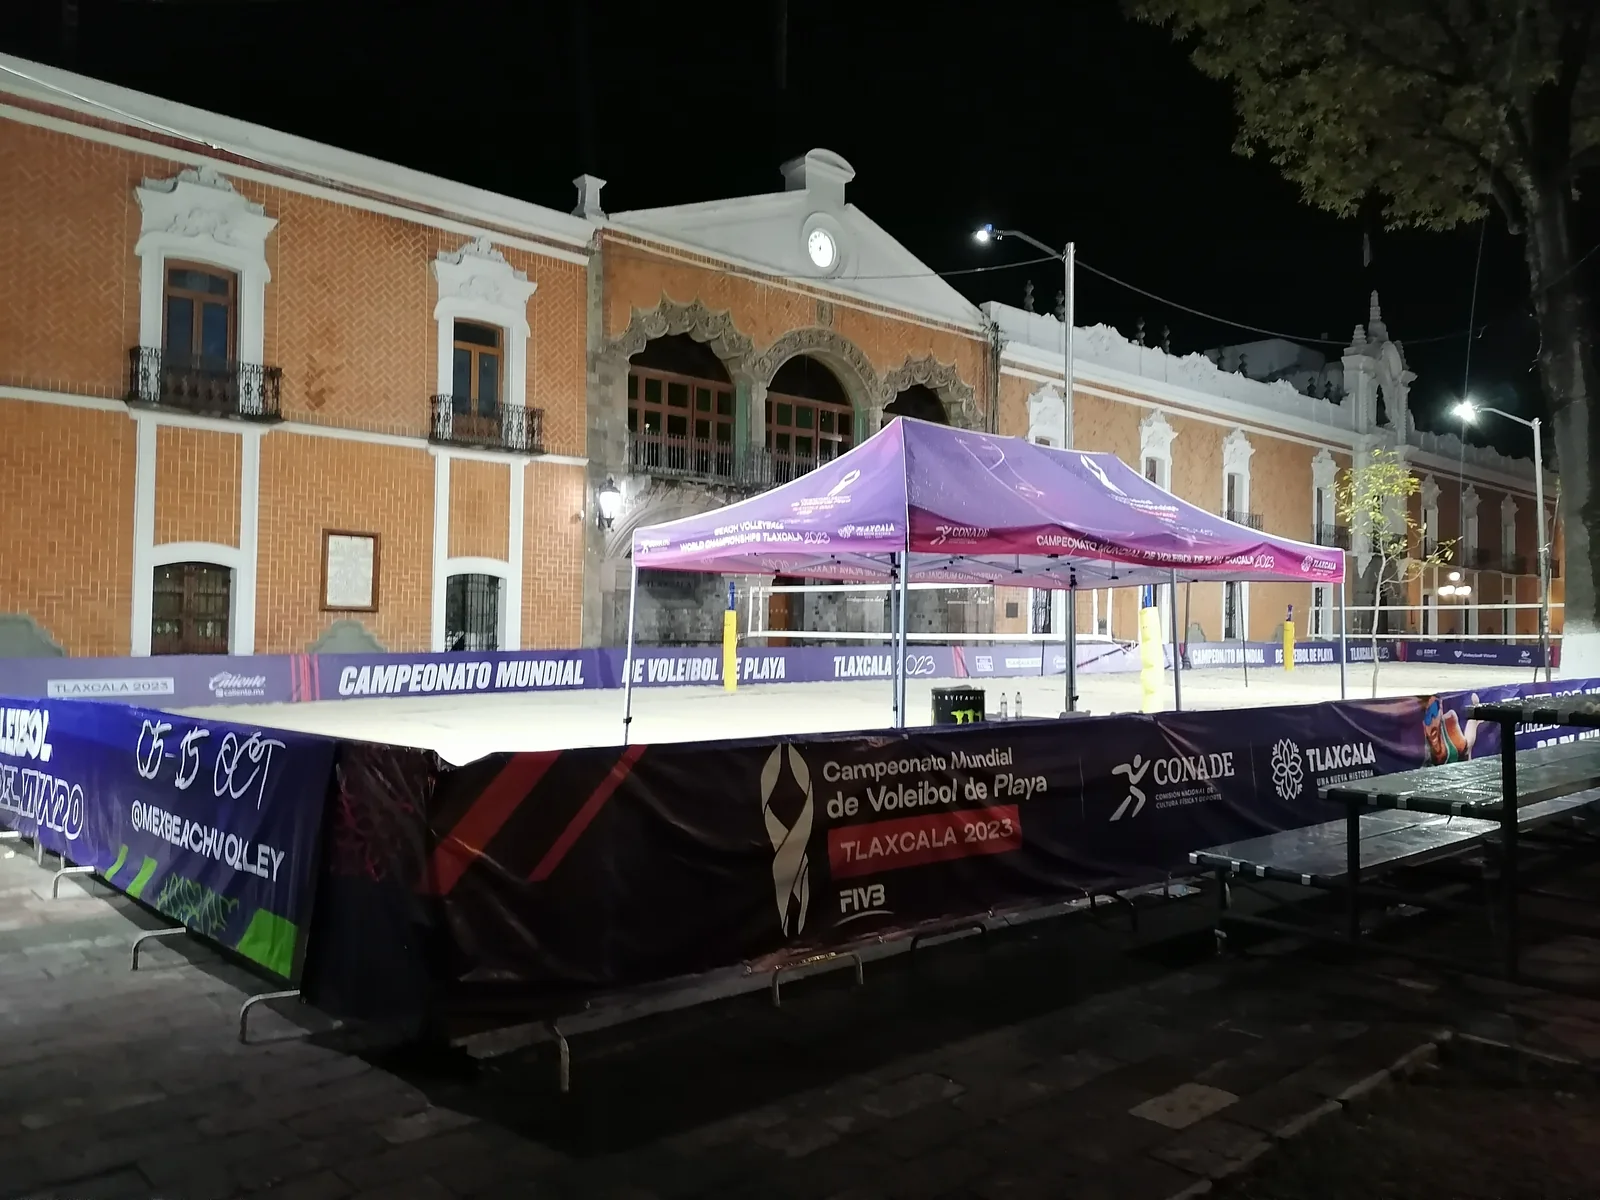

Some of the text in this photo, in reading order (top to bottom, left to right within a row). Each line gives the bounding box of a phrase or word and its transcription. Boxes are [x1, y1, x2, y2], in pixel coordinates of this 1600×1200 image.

[713, 520, 784, 536] BEACH VOLLEYBALL
[762, 532, 803, 542] TLAXCALA
[804, 531, 830, 544] 2023
[952, 527, 990, 537] CONADE
[1036, 535, 1097, 551] CAMPEONATO
[1254, 554, 1275, 568] 2023
[338, 659, 584, 695] CAMPEONATO MUNDIAL
[648, 657, 720, 682] VOLEIBOL
[722, 657, 742, 681] E
[743, 656, 786, 680] PLAYA
[833, 655, 892, 677] TLAXCALA
[54, 680, 169, 694] TLAXCALA 2023
[823, 746, 1013, 783] Campeonato Mundial
[1153, 751, 1235, 785] CONADE
[1306, 742, 1376, 772] TLAXCALA
[1316, 778, 1330, 787] UNA
[1330, 773, 1348, 783] NUEVA
[827, 773, 1048, 819] de Voleibol de Playa
[840, 817, 1013, 863] TLAXCALA 2023
